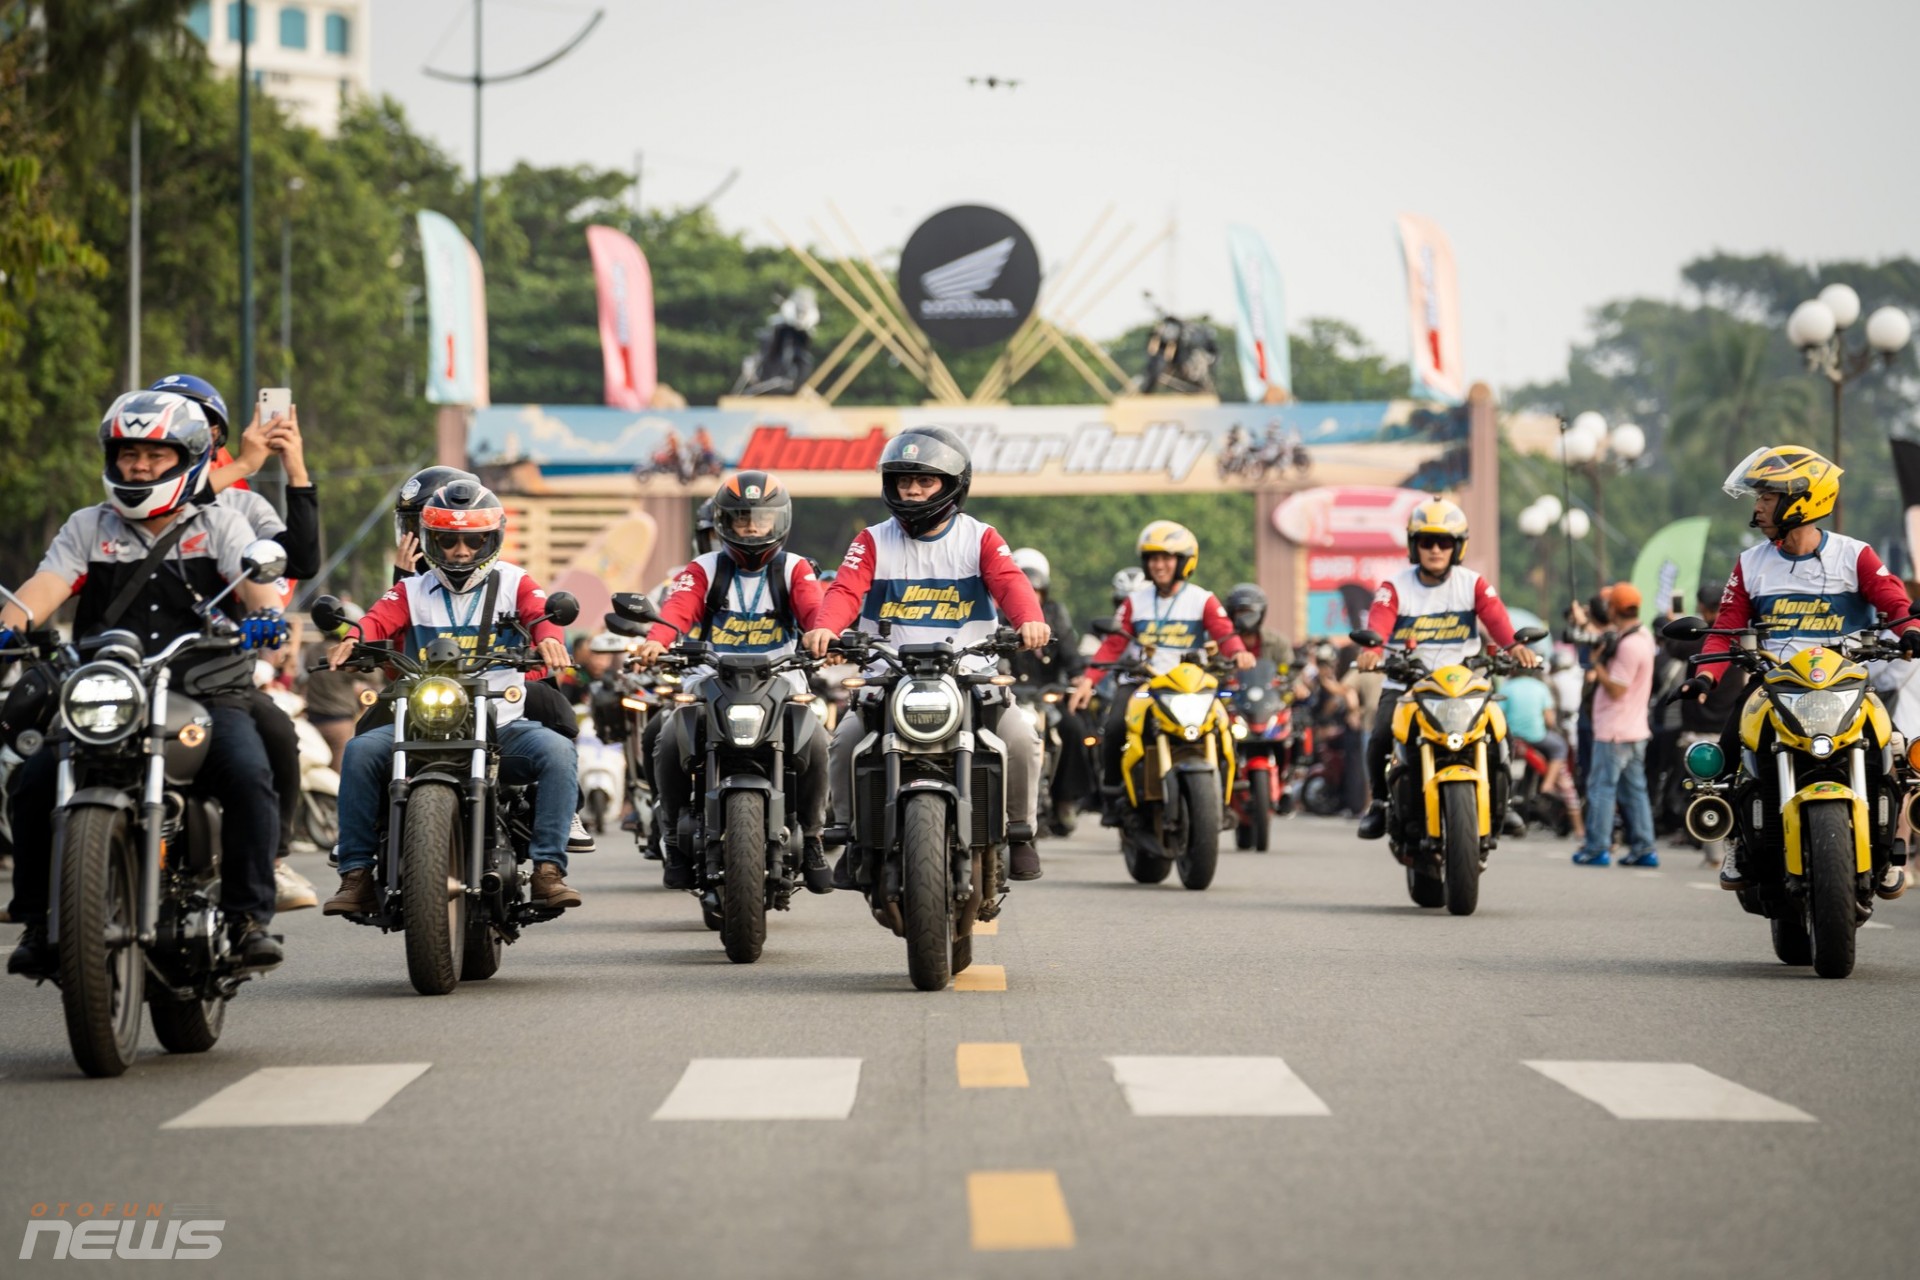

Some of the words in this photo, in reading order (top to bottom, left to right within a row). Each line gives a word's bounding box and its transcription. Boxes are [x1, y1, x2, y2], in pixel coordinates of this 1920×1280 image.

[738, 426, 887, 470] Hond
[1063, 421, 1215, 482] Rally
[901, 585, 960, 602] Honda
[879, 602, 933, 619] Biker
[931, 601, 975, 620] Rally
[1772, 598, 1832, 615] Honda
[1413, 614, 1460, 629] Honda
[1798, 614, 1846, 633] Rally
